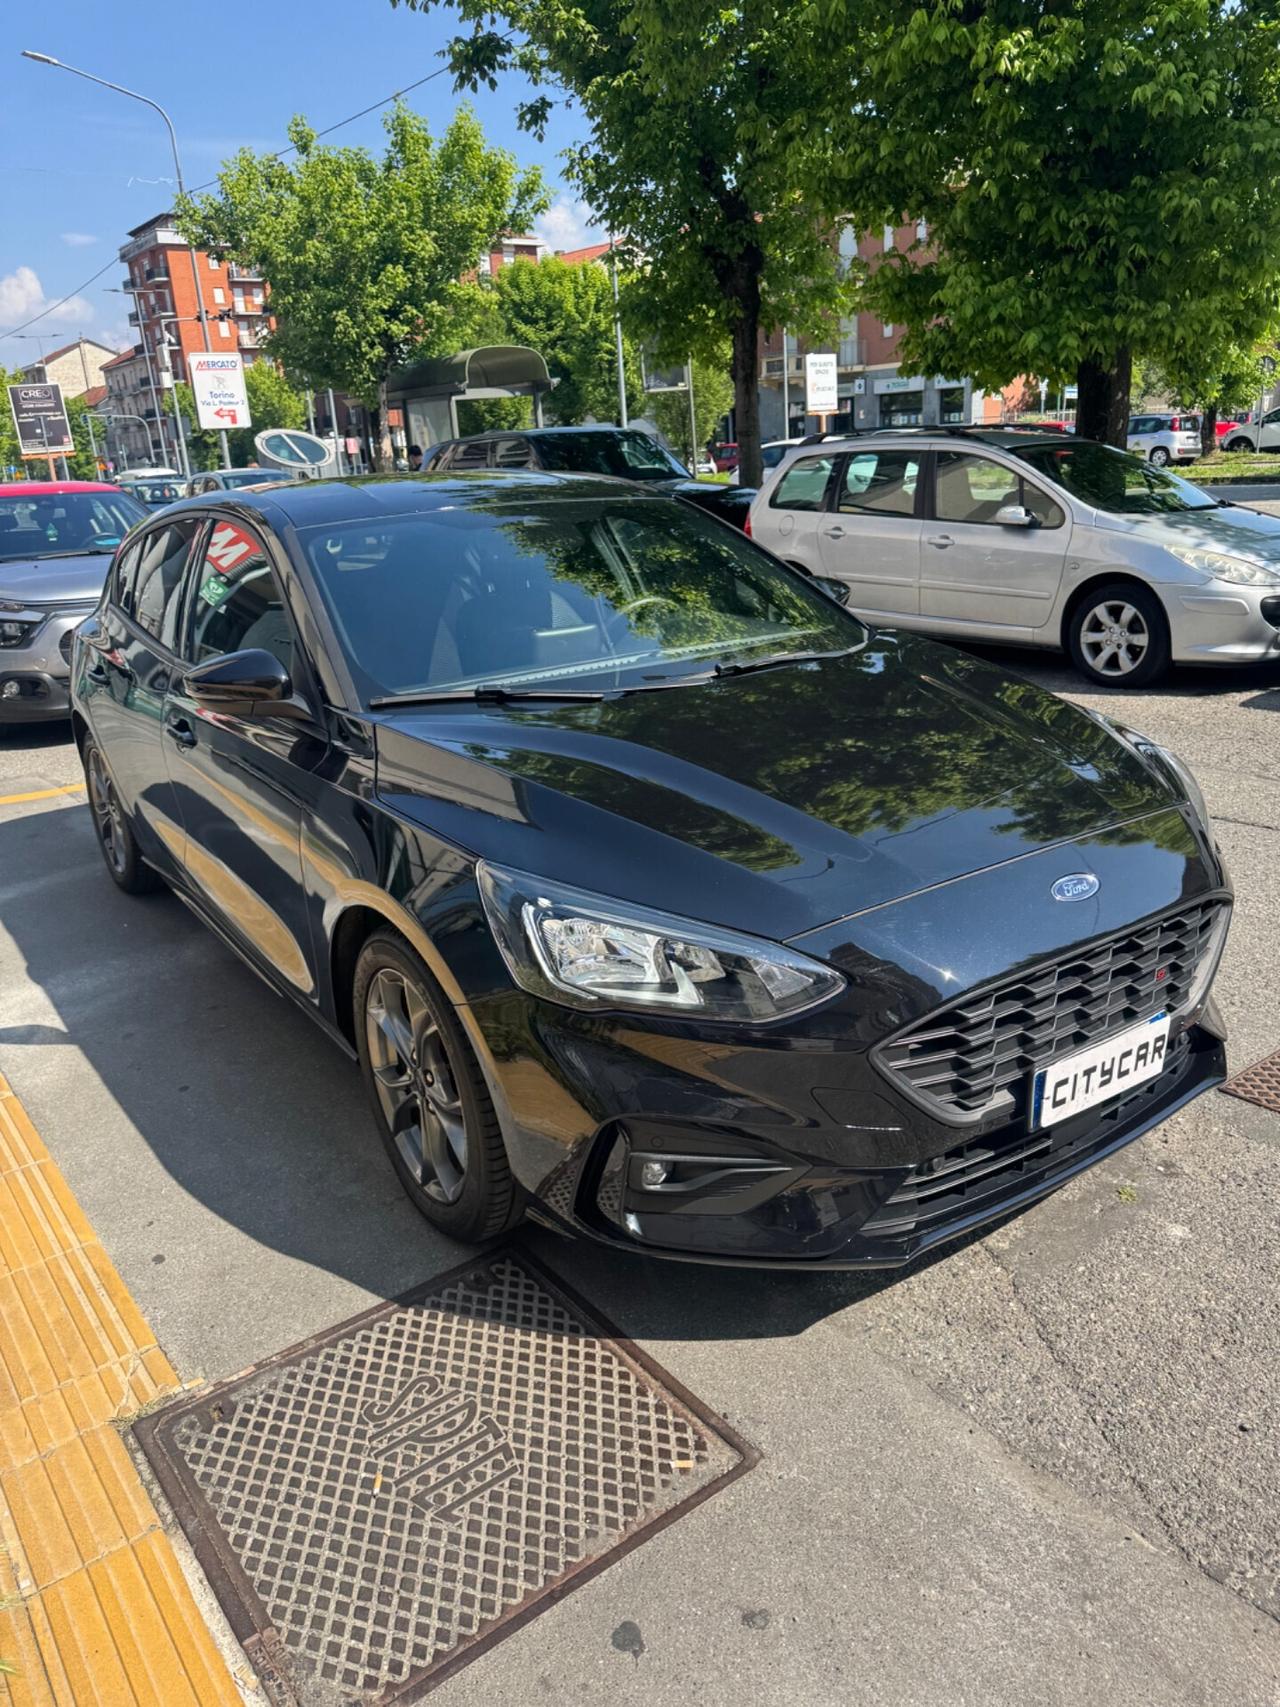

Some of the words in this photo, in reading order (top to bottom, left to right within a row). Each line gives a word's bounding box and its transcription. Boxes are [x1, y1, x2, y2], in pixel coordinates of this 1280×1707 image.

[196, 360, 237, 370] MERCATO
[21, 389, 50, 399] CREO
[209, 391, 236, 399] Torino
[1063, 880, 1089, 897] Ford
[1051, 1033, 1167, 1110] CITYCAR
